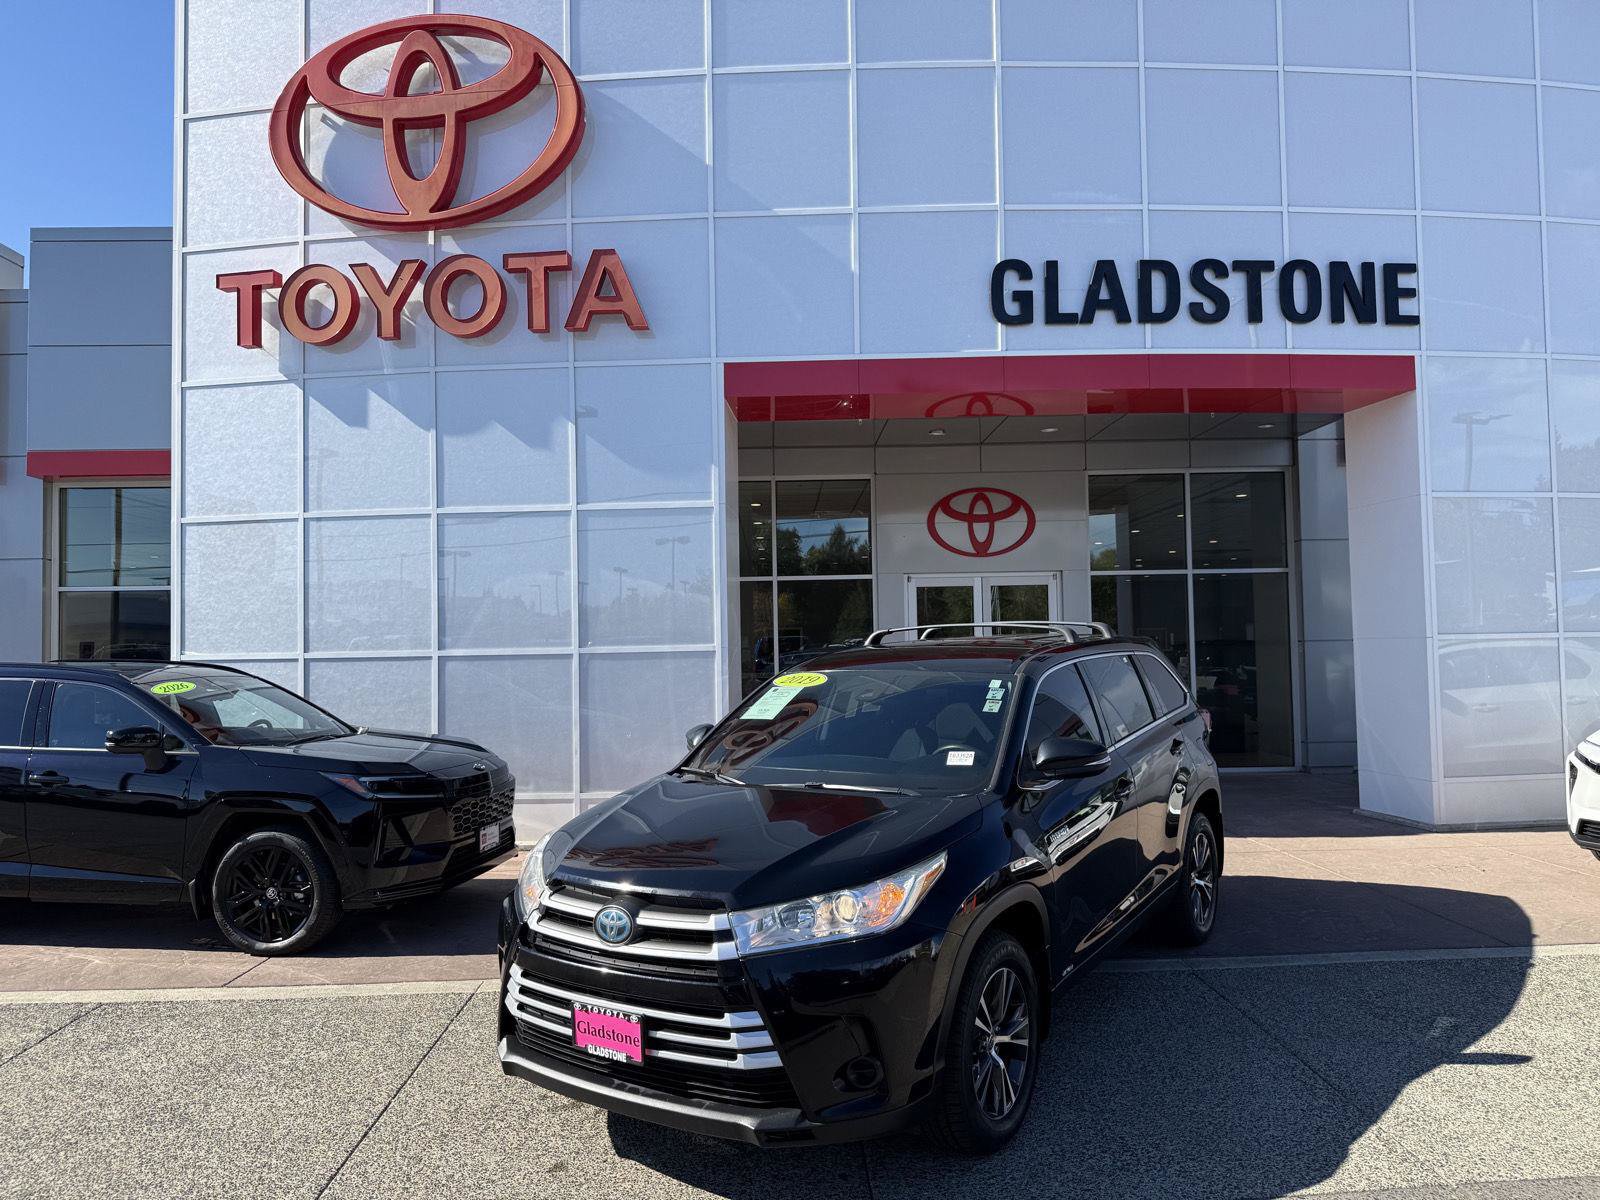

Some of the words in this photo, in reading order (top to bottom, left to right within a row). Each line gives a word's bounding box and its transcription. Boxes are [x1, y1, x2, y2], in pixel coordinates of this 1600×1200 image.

[216, 248, 649, 349] TOYOTA
[990, 257, 1421, 326] GLADSTONE
[159, 682, 190, 693] 2026
[779, 674, 821, 686] 2019
[586, 1004, 625, 1020] TOYOTA
[576, 1020, 641, 1047] Gladstone
[587, 1044, 627, 1063] GLADSTONE
